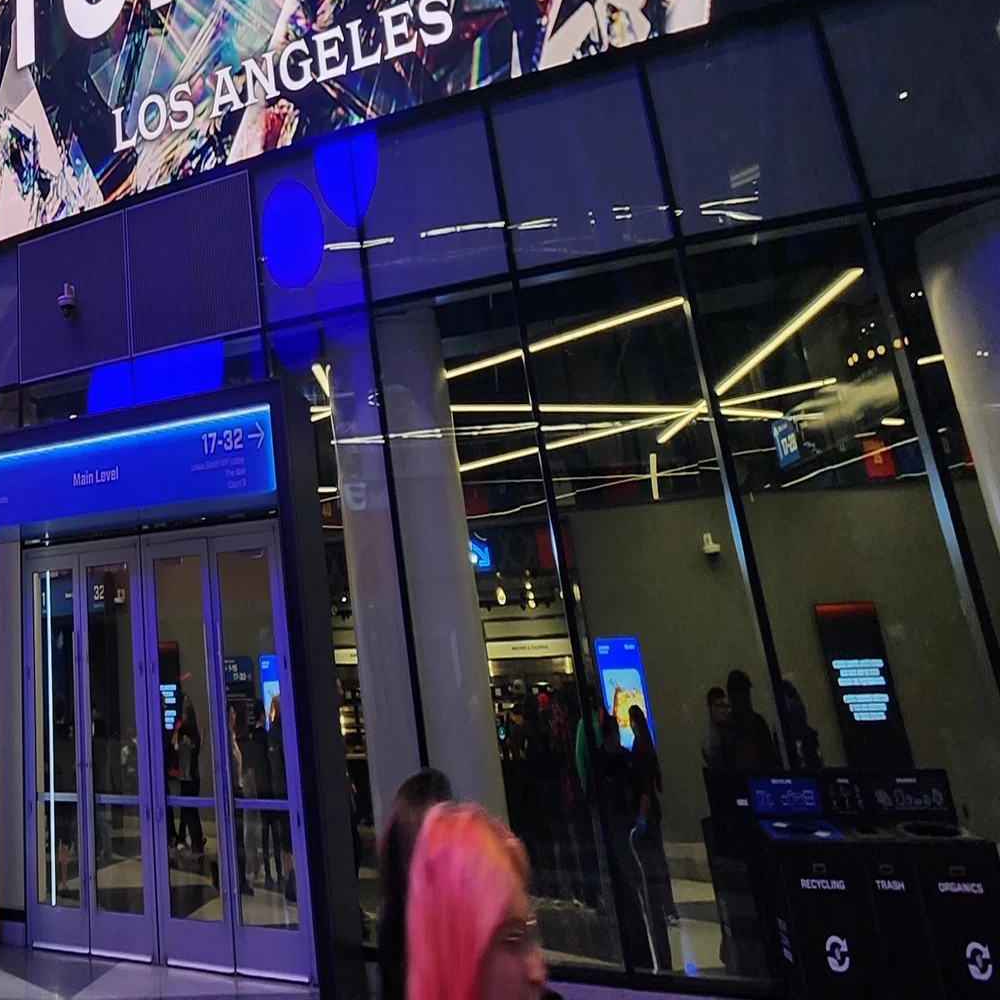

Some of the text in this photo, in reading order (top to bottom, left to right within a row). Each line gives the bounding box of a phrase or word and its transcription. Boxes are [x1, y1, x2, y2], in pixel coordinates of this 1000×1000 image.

[111, 81, 195, 153] LOS
[201, 427, 244, 455] 17-32
[72, 466, 119, 487] Main Level
[800, 878, 846, 891] RECYCLING
[875, 879, 905, 891] TRASH
[937, 881, 984, 895] ORGANICS
